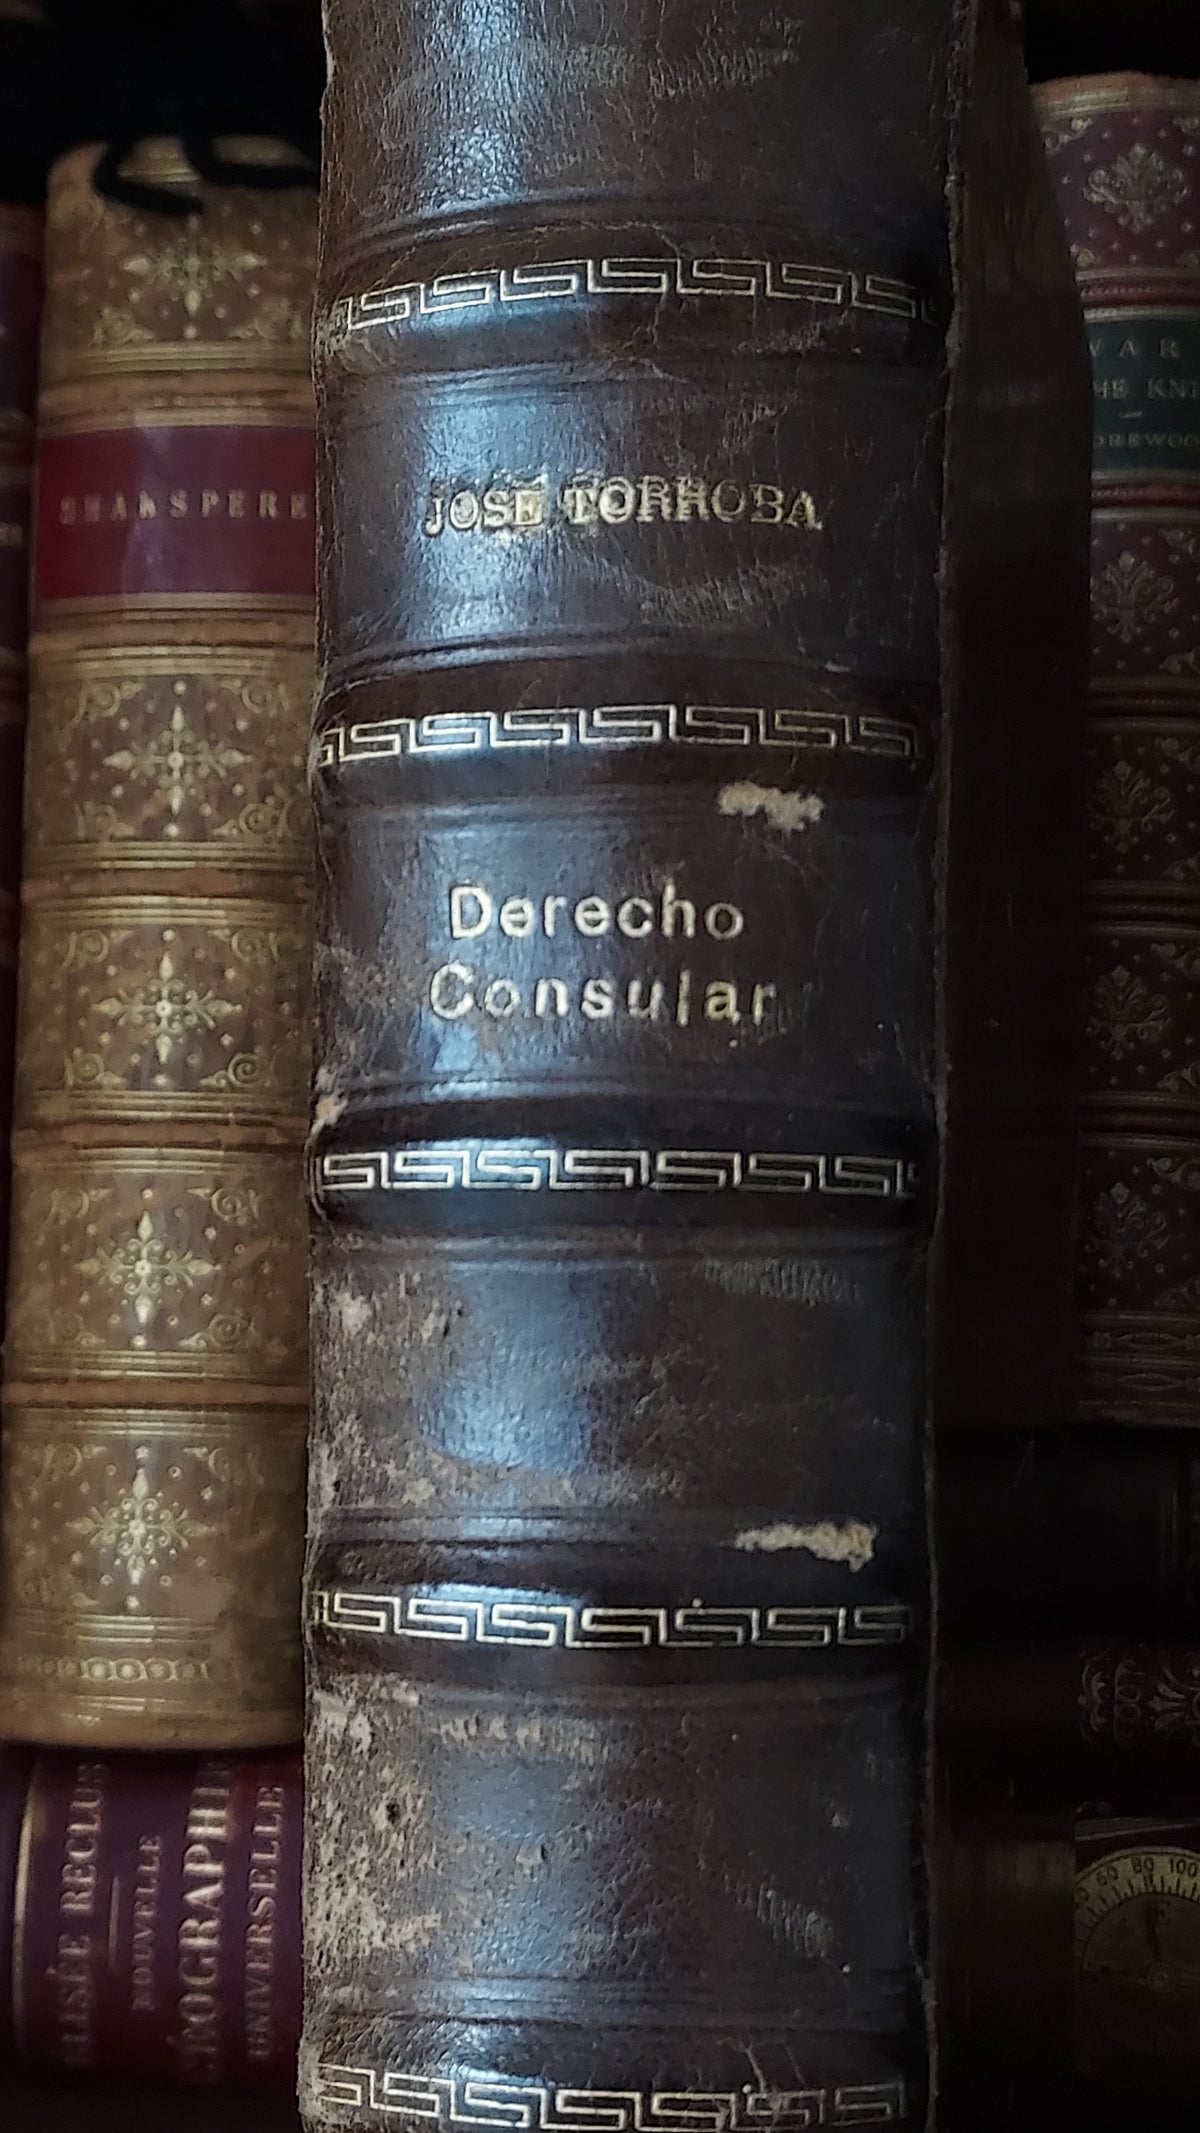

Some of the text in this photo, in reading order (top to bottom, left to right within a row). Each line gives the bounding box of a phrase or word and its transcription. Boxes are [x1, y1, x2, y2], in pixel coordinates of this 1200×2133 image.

[449, 878, 746, 940] Derecho
[430, 959, 778, 1028] Consular
[60, 1762, 108, 1914] RECLUS
[1096, 1866, 1119, 1887] 60
[1132, 1857, 1155, 1875] 80
[1169, 1858, 1198, 1878] 100
[131, 1835, 162, 2012] NOUVELLE
[246, 1785, 285, 2060] UNIVERSELLE
